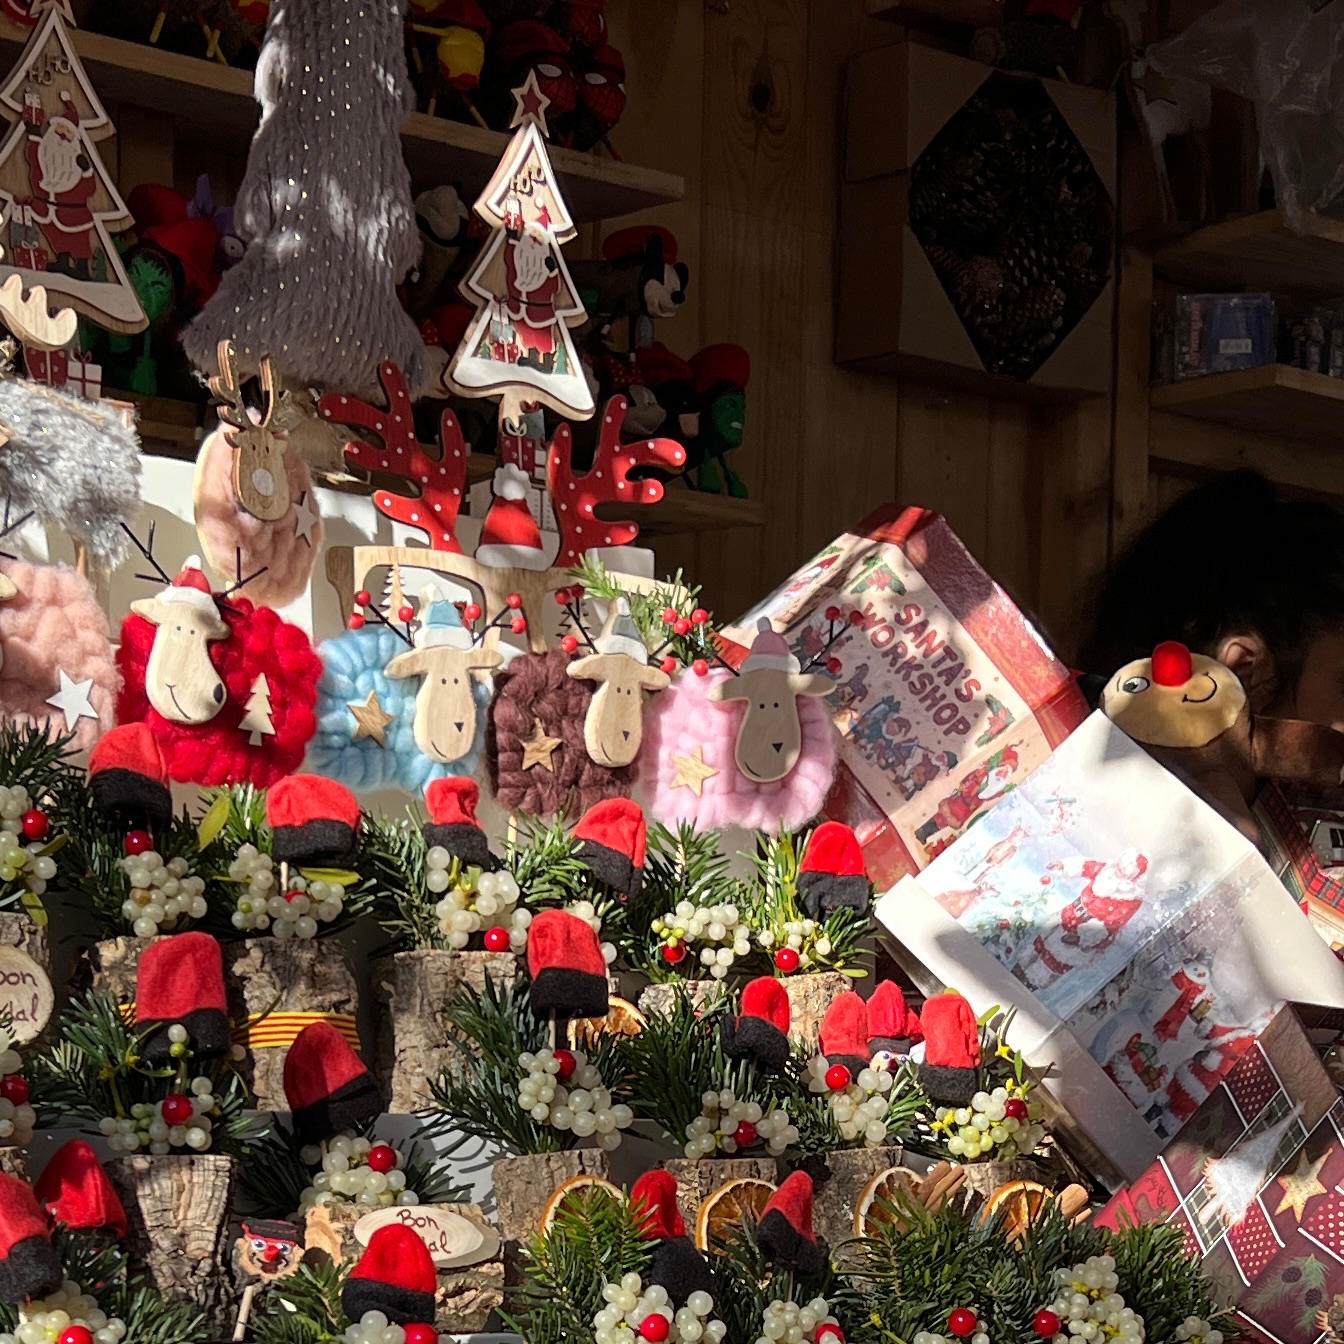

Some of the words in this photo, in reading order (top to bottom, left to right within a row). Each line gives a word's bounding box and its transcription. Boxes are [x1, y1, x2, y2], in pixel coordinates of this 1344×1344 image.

[860, 602, 972, 737] WORKSHOP
[894, 603, 982, 703] SANTA'S
[396, 1208, 440, 1230] Bon
